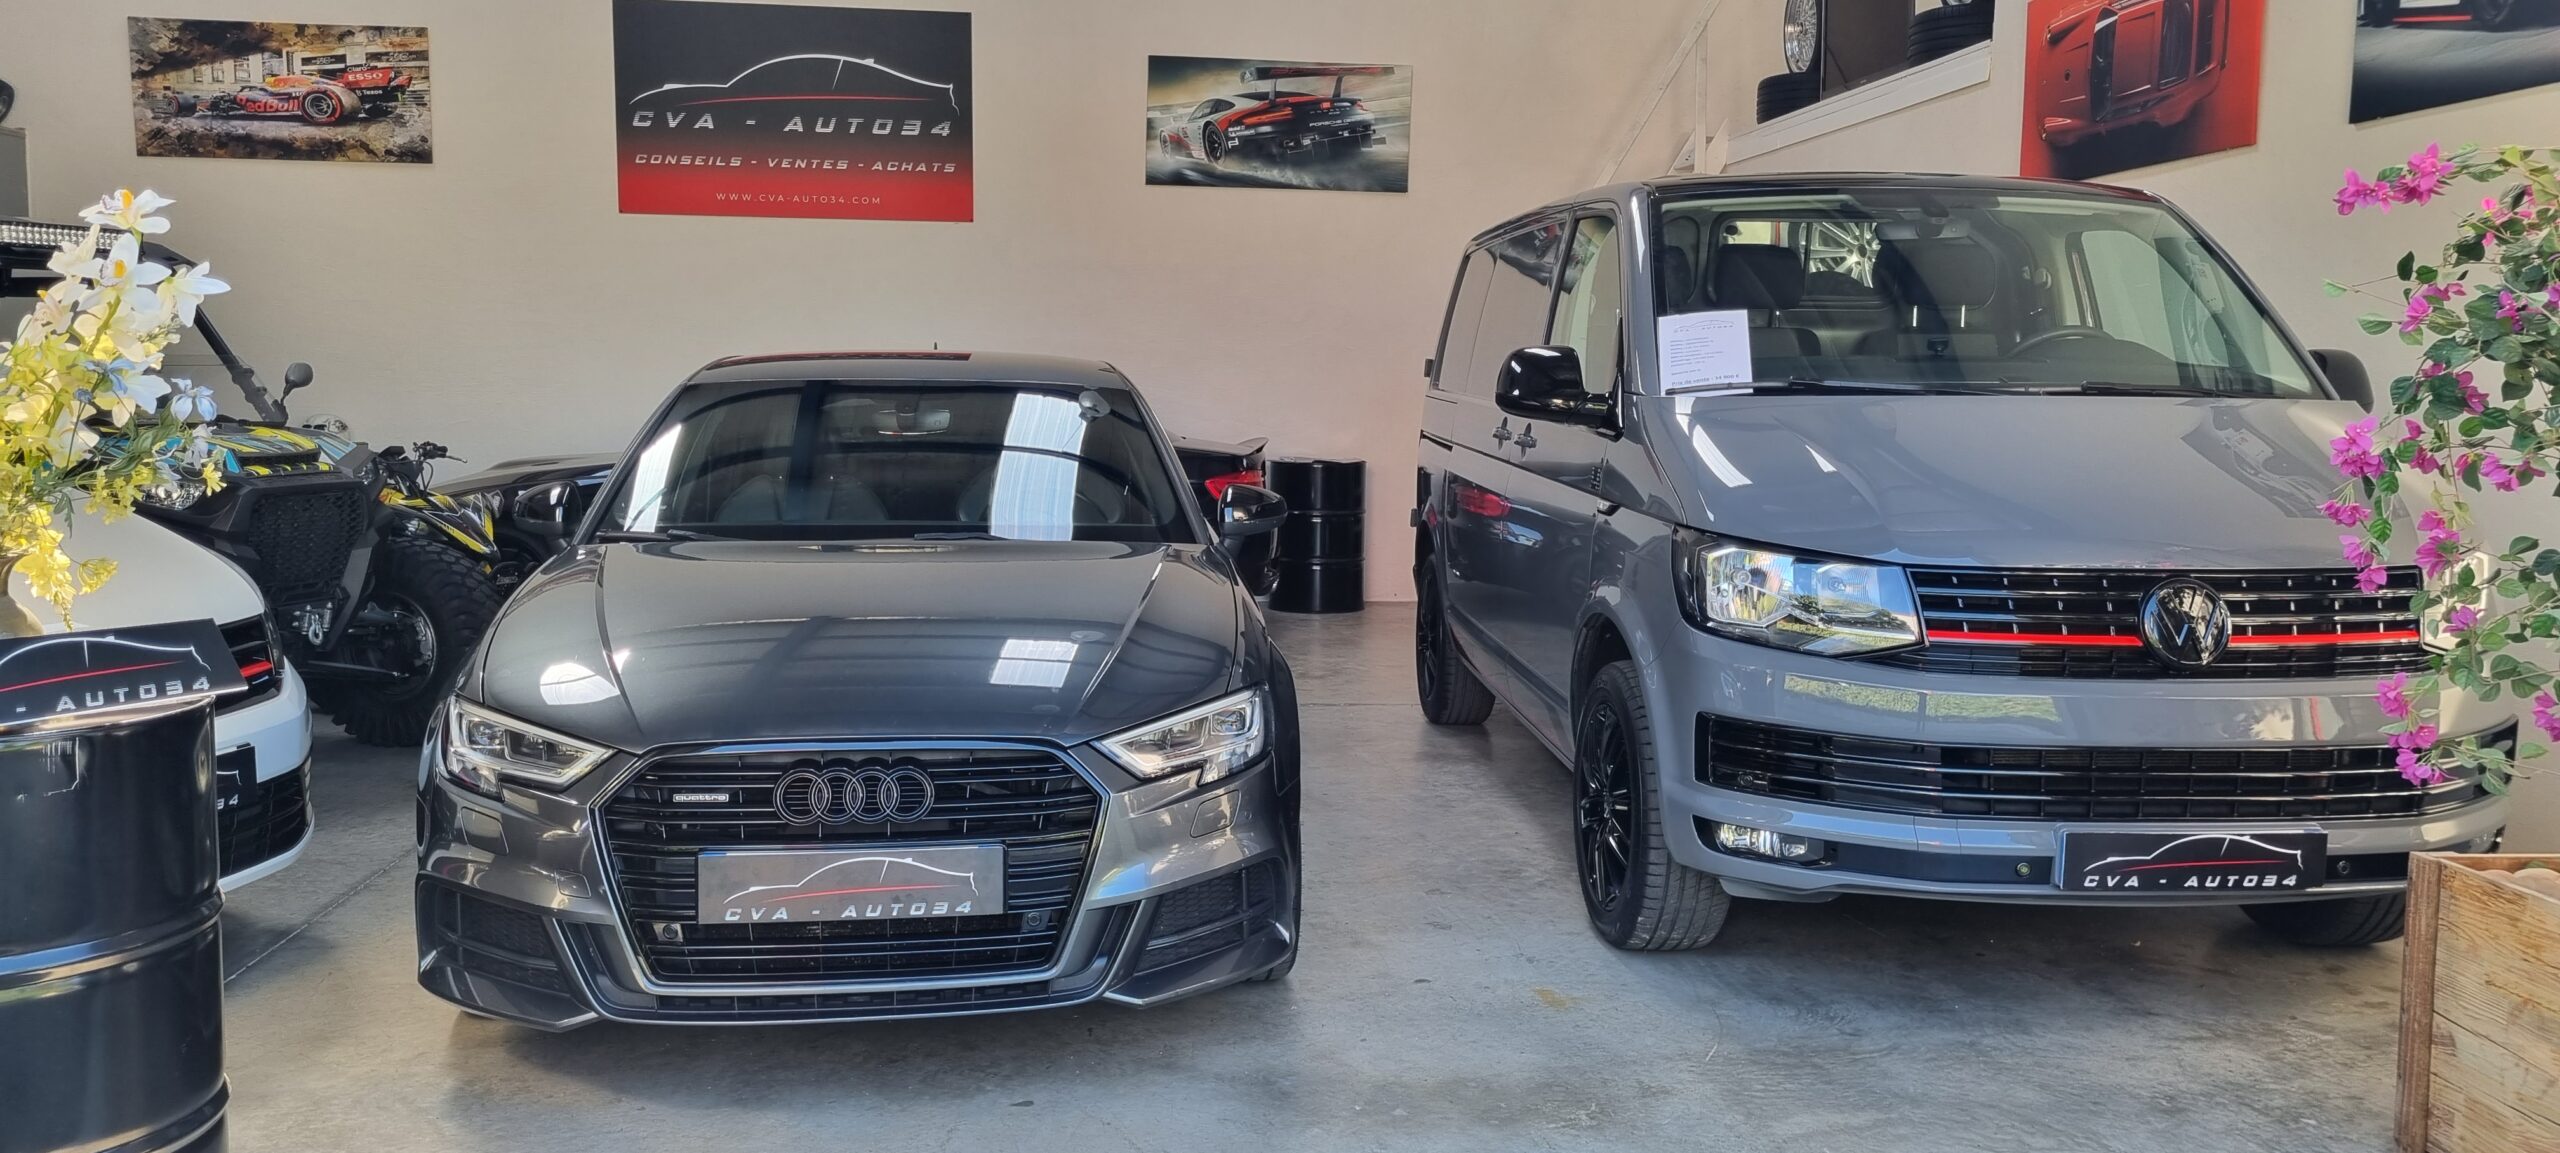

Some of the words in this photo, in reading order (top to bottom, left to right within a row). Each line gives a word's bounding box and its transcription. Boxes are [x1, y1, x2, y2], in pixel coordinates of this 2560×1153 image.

[348, 71, 384, 81] ESSO
[632, 111, 715, 129] CVA
[783, 116, 951, 137] AUTO34
[635, 154, 743, 167] CONSEILS
[767, 158, 849, 171] VENTES
[871, 161, 957, 173] ACHATS
[716, 192, 881, 205] WWW.CVA-AUTO34.COM
[56, 676, 211, 712] AUTO34
[675, 794, 727, 802] quattro
[2083, 875, 2140, 888] CVA
[2184, 874, 2297, 888] AUTO34
[724, 906, 789, 921] CVA
[840, 901, 973, 919] AUTO34
